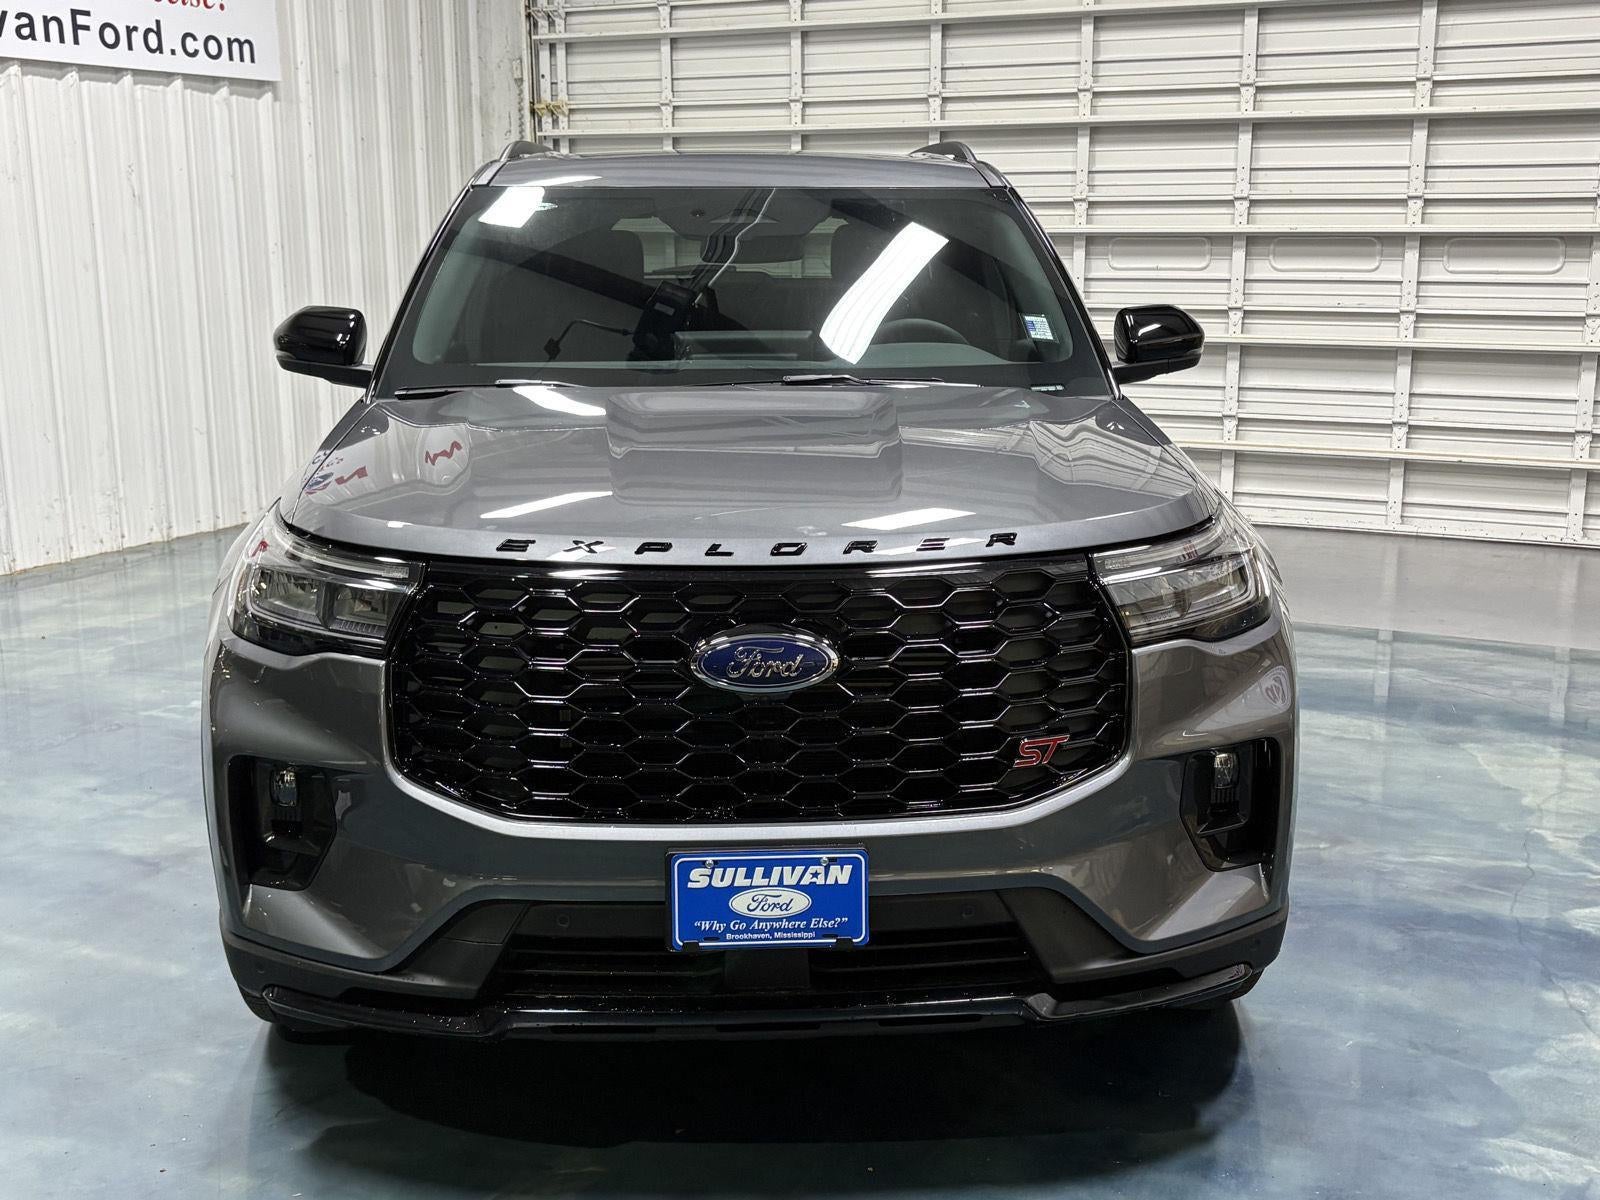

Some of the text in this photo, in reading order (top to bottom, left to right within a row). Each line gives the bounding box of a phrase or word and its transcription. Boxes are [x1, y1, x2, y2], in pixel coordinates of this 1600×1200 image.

[496, 532, 1018, 557] EXPLORER
[726, 645, 804, 679] Ford
[1013, 734, 1070, 767] ST
[687, 865, 852, 888] SULLIVAN
[746, 893, 794, 913] Ford
[730, 920, 746, 930] Go
[750, 919, 806, 932] Anywhere
[774, 931, 815, 939] Mississippi
